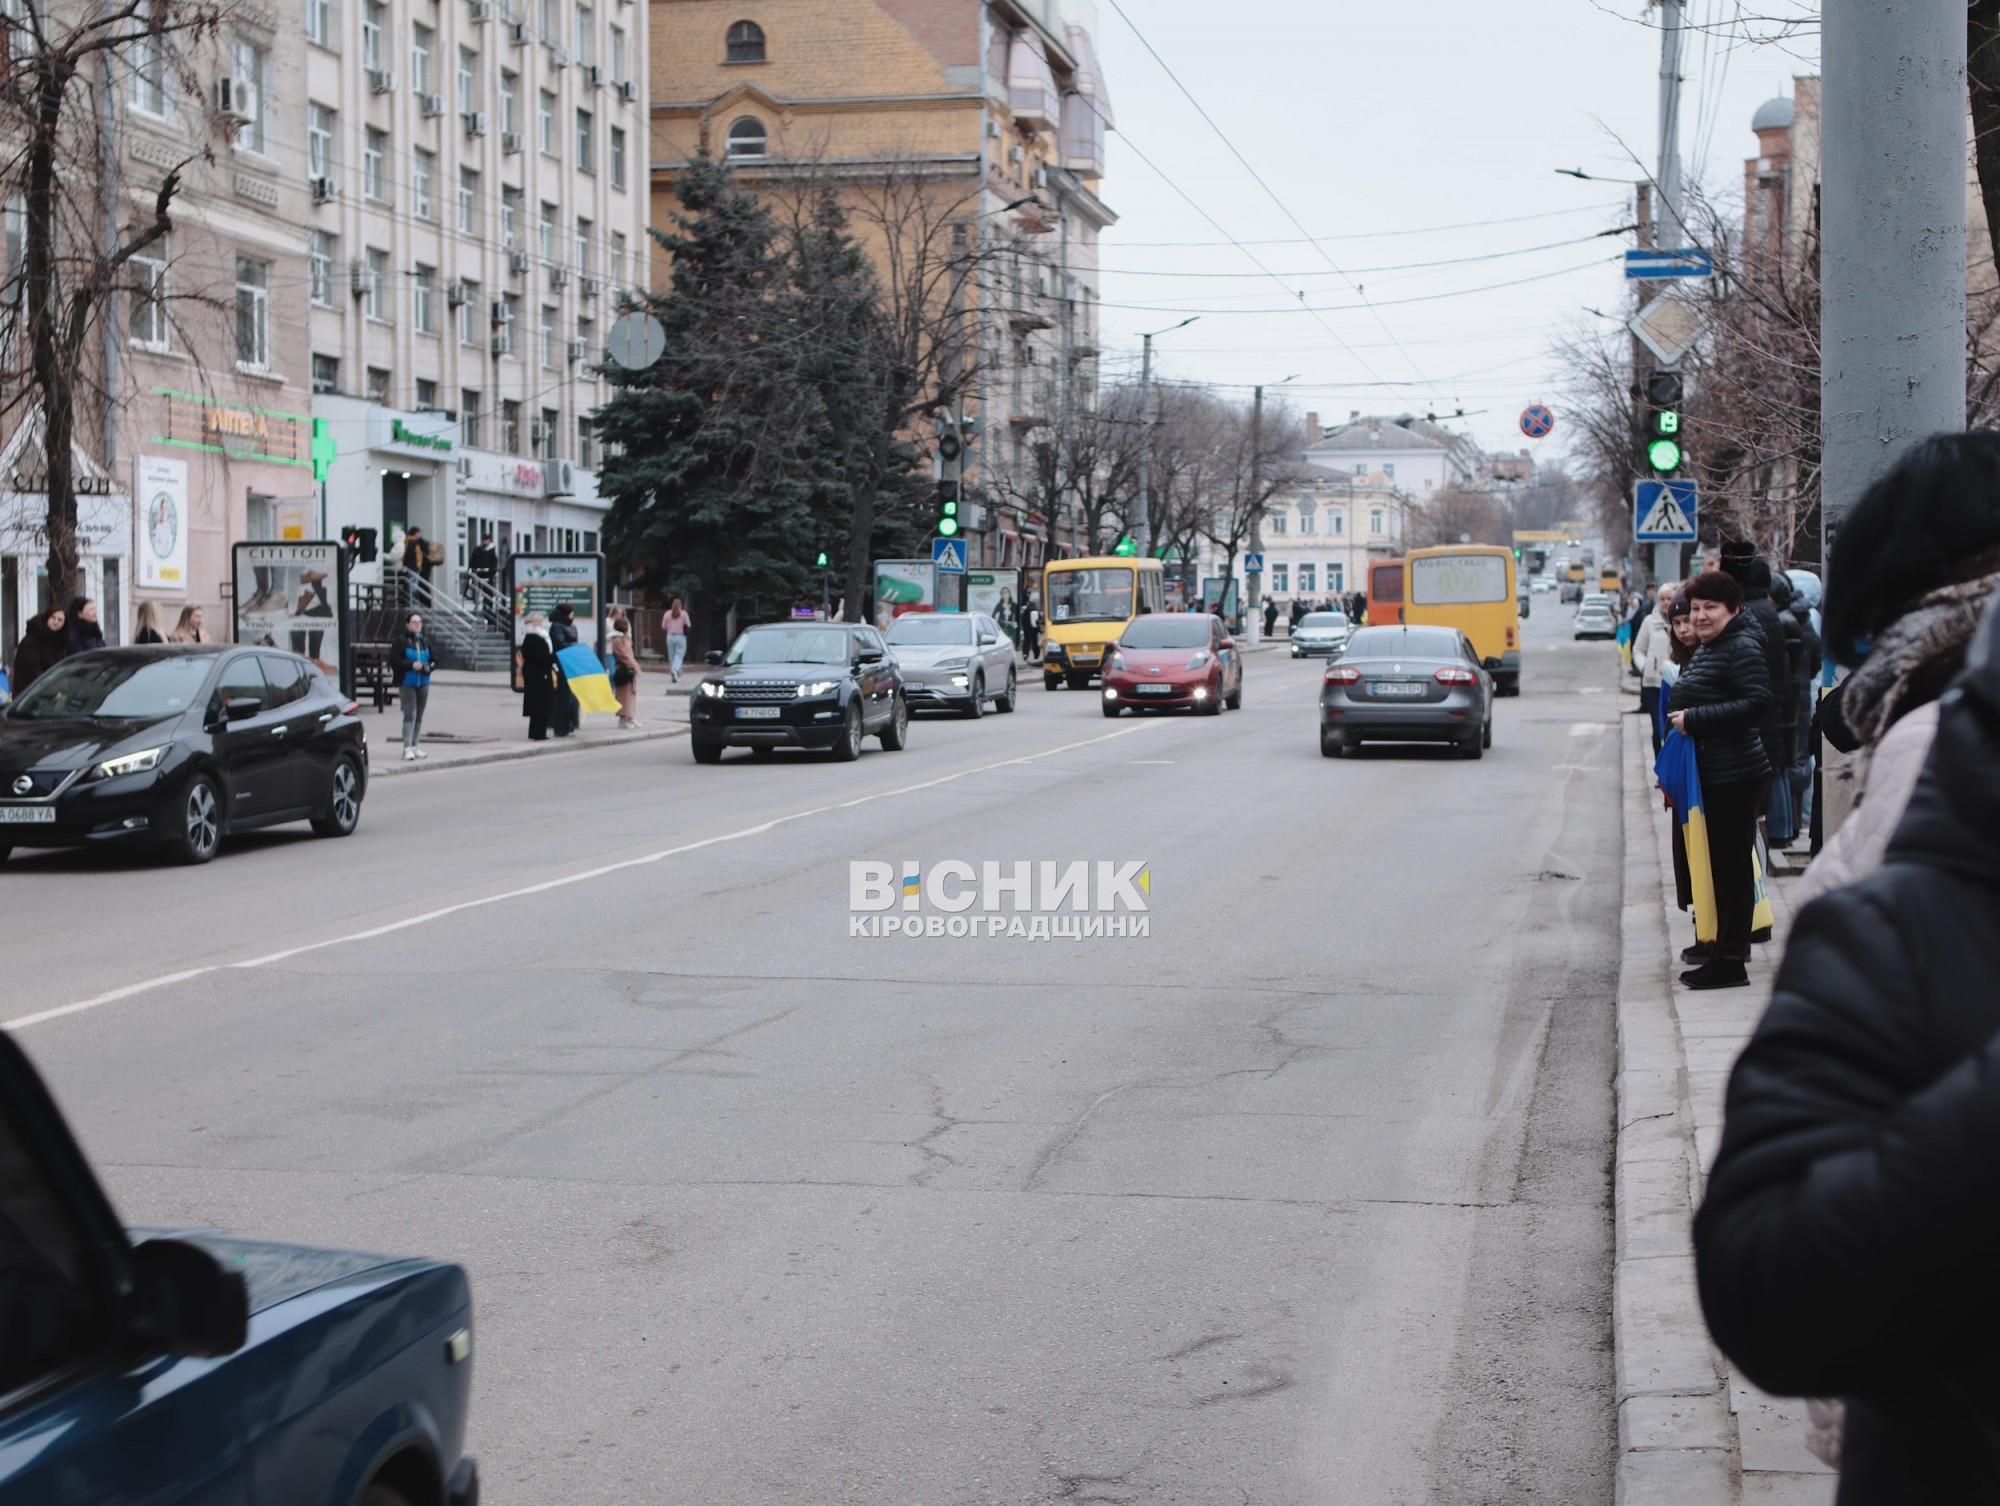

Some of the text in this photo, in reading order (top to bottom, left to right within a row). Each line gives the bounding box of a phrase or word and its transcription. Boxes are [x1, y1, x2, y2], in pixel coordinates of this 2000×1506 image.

[249, 547, 326, 559] СІТІ ТОП
[1077, 571, 1103, 594] 21
[1057, 605, 1070, 619] 21
